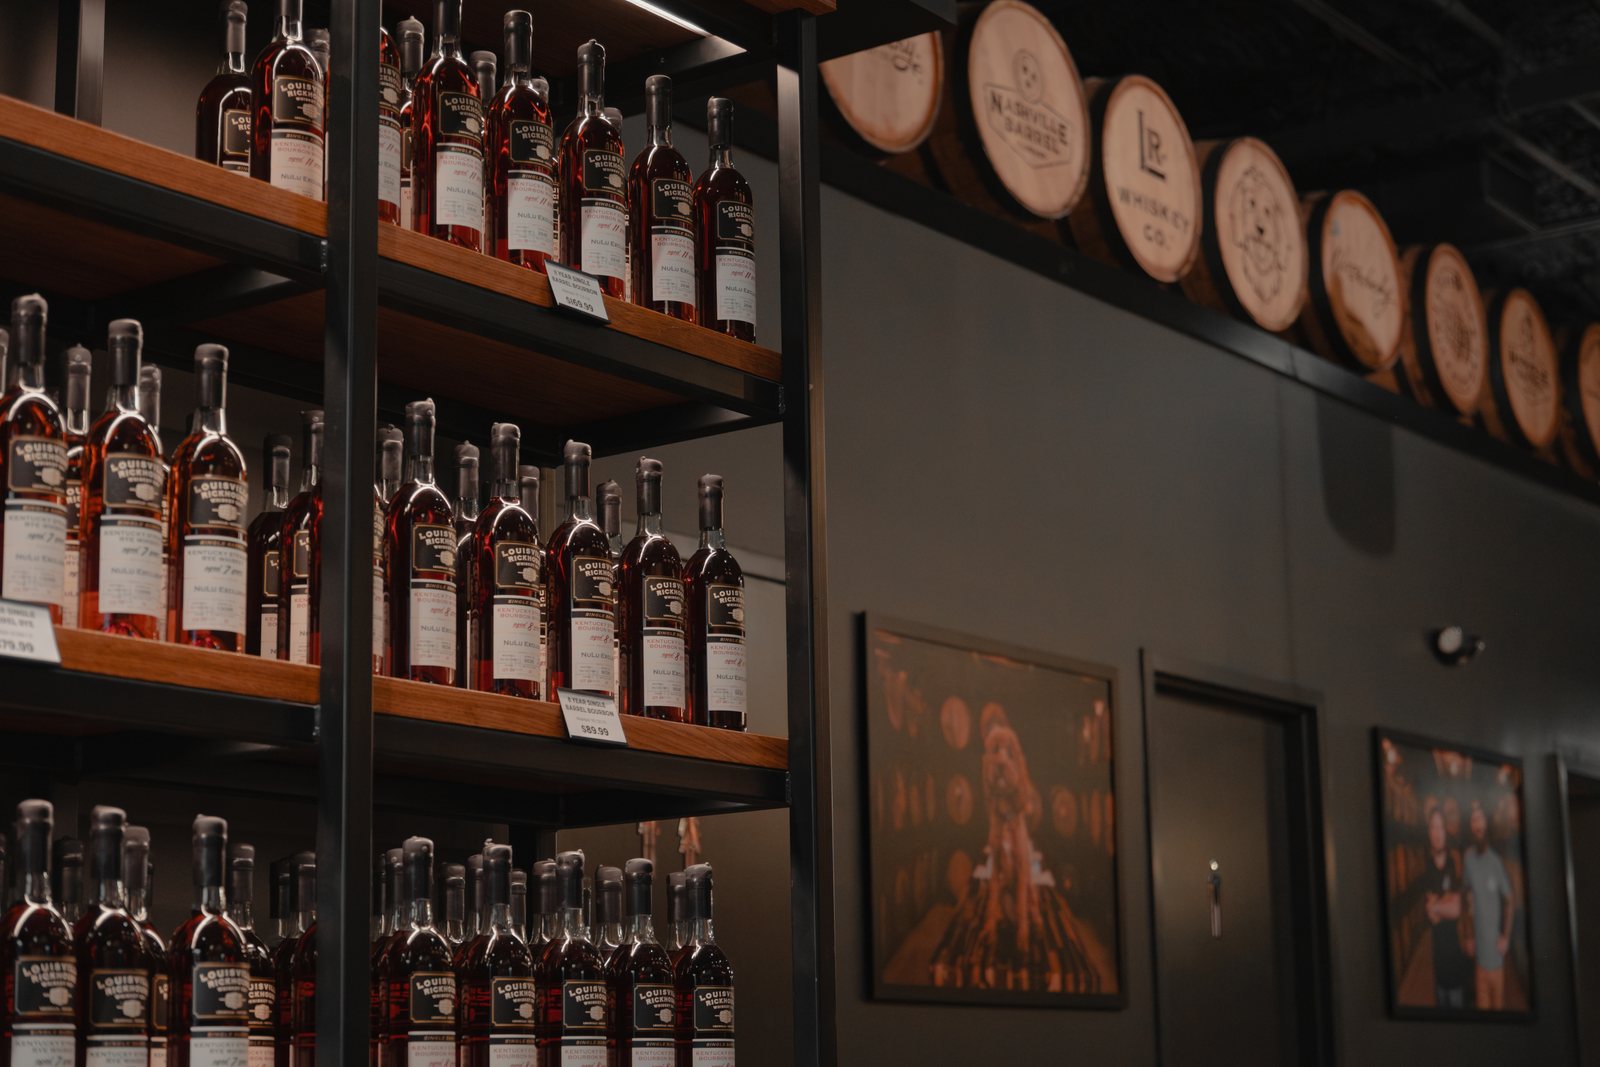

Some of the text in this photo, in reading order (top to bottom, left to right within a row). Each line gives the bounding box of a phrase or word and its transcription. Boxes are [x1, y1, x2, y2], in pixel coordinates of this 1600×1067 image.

[991, 90, 1068, 146] NASHVILLE
[1005, 116, 1060, 155] BARREL
[1118, 187, 1190, 234] WHISKEY
[581, 724, 609, 736] $89.99
